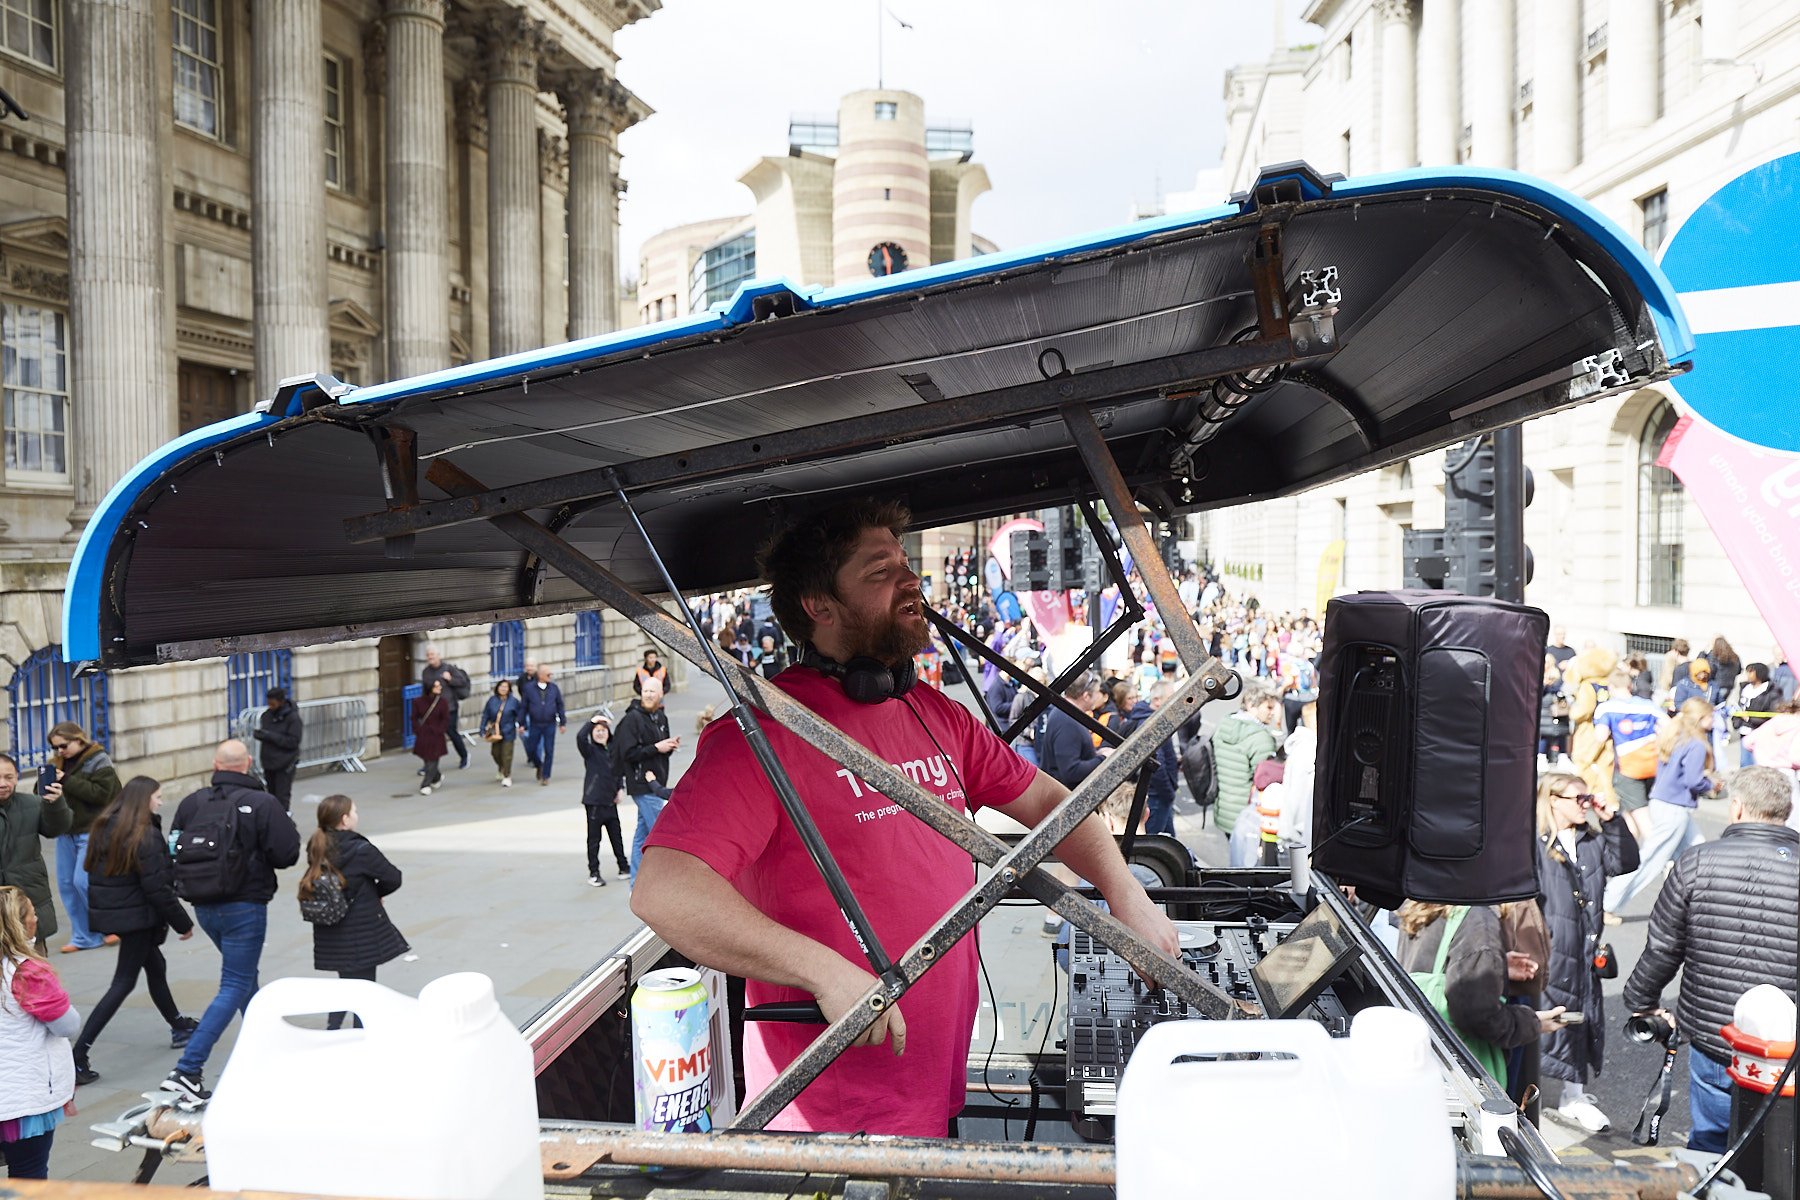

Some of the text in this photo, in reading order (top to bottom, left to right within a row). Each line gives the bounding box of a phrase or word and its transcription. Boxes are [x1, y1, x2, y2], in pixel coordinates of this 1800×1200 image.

[854, 810, 875, 823] The
[654, 1079, 710, 1123] ENERG
[679, 1109, 705, 1128] ZERO
